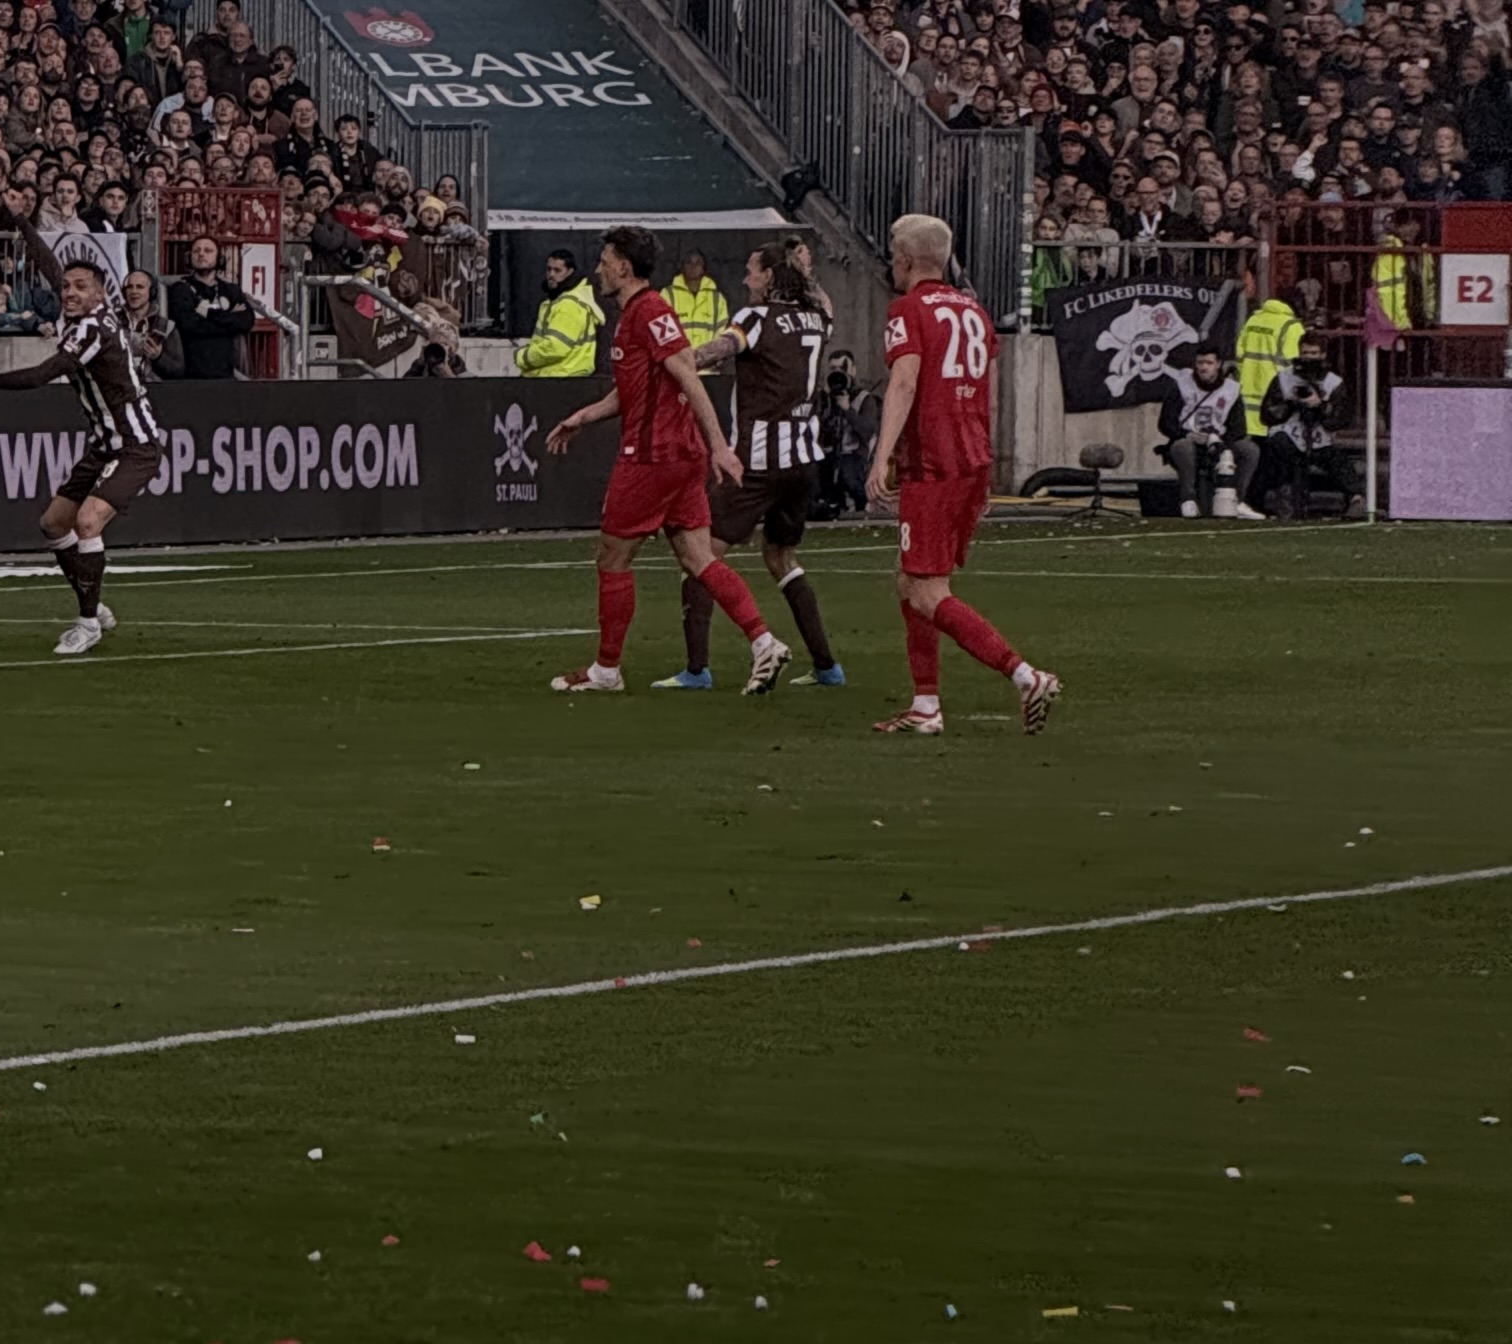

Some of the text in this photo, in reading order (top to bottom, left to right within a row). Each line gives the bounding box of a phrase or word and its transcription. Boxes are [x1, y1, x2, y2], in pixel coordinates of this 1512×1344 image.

[362, 50, 635, 78] LBANK
[1457, 275, 1494, 304] E2
[1063, 297, 1087, 320] FC
[934, 306, 988, 380] 28
[801, 335, 822, 401] 7
